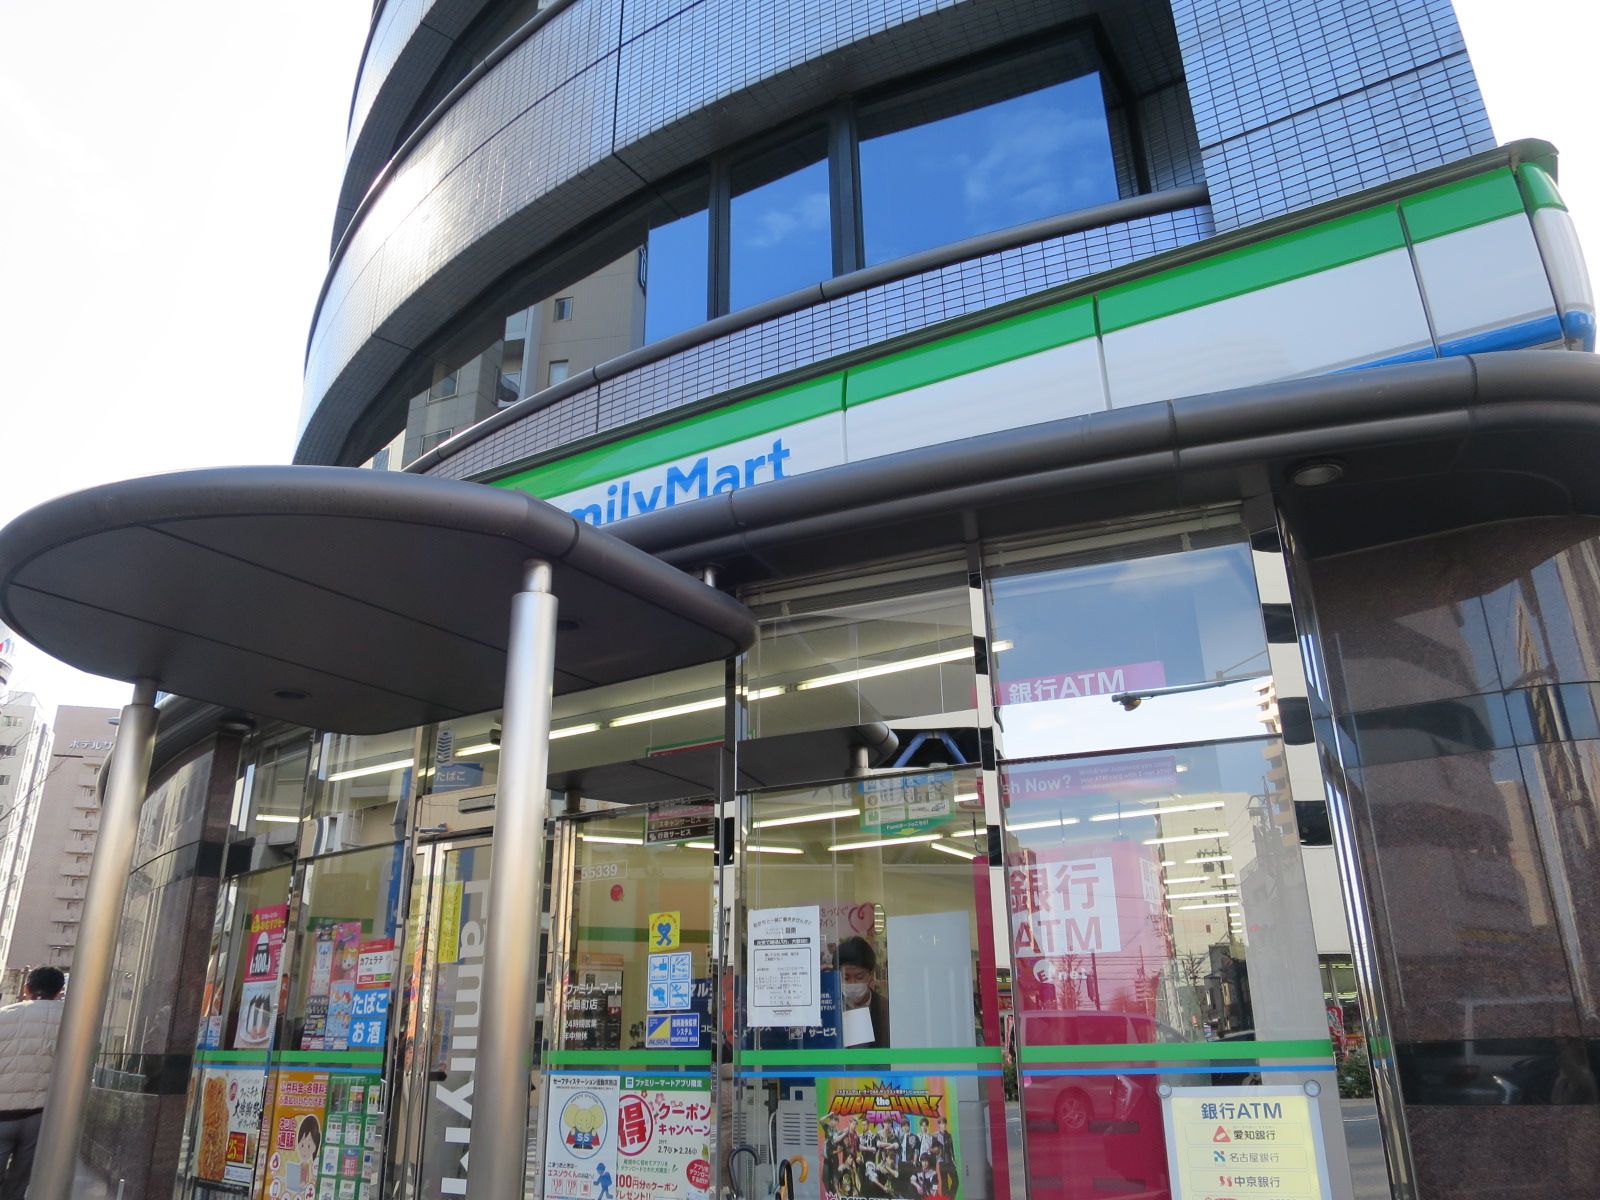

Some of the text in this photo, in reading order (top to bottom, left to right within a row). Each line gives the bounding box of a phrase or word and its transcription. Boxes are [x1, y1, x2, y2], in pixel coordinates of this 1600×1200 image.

[1008, 669, 1125, 704] 銀行ATM
[1025, 775, 1071, 793] Now?
[1010, 863, 1099, 914] 銀行
[1015, 916, 1103, 954] ATM
[565, 982, 622, 995] ファミリーマート
[352, 992, 388, 1015] たばこ
[352, 1021, 382, 1044] お酒
[809, 1028, 837, 1038] サービス
[658, 1102, 712, 1121] クーポン
[830, 1096, 874, 1116] BURN
[876, 1097, 890, 1106] the
[1201, 1102, 1283, 1120] 銀行ATM
[618, 1101, 648, 1148] 得
[658, 1124, 711, 1137] キャンペーン
[576, 1132, 590, 1143] SS
[1233, 1129, 1276, 1141] 愛知銀行
[1229, 1152, 1279, 1163] 名古屋銀行
[1234, 1176, 1280, 1188] 中京銀行
